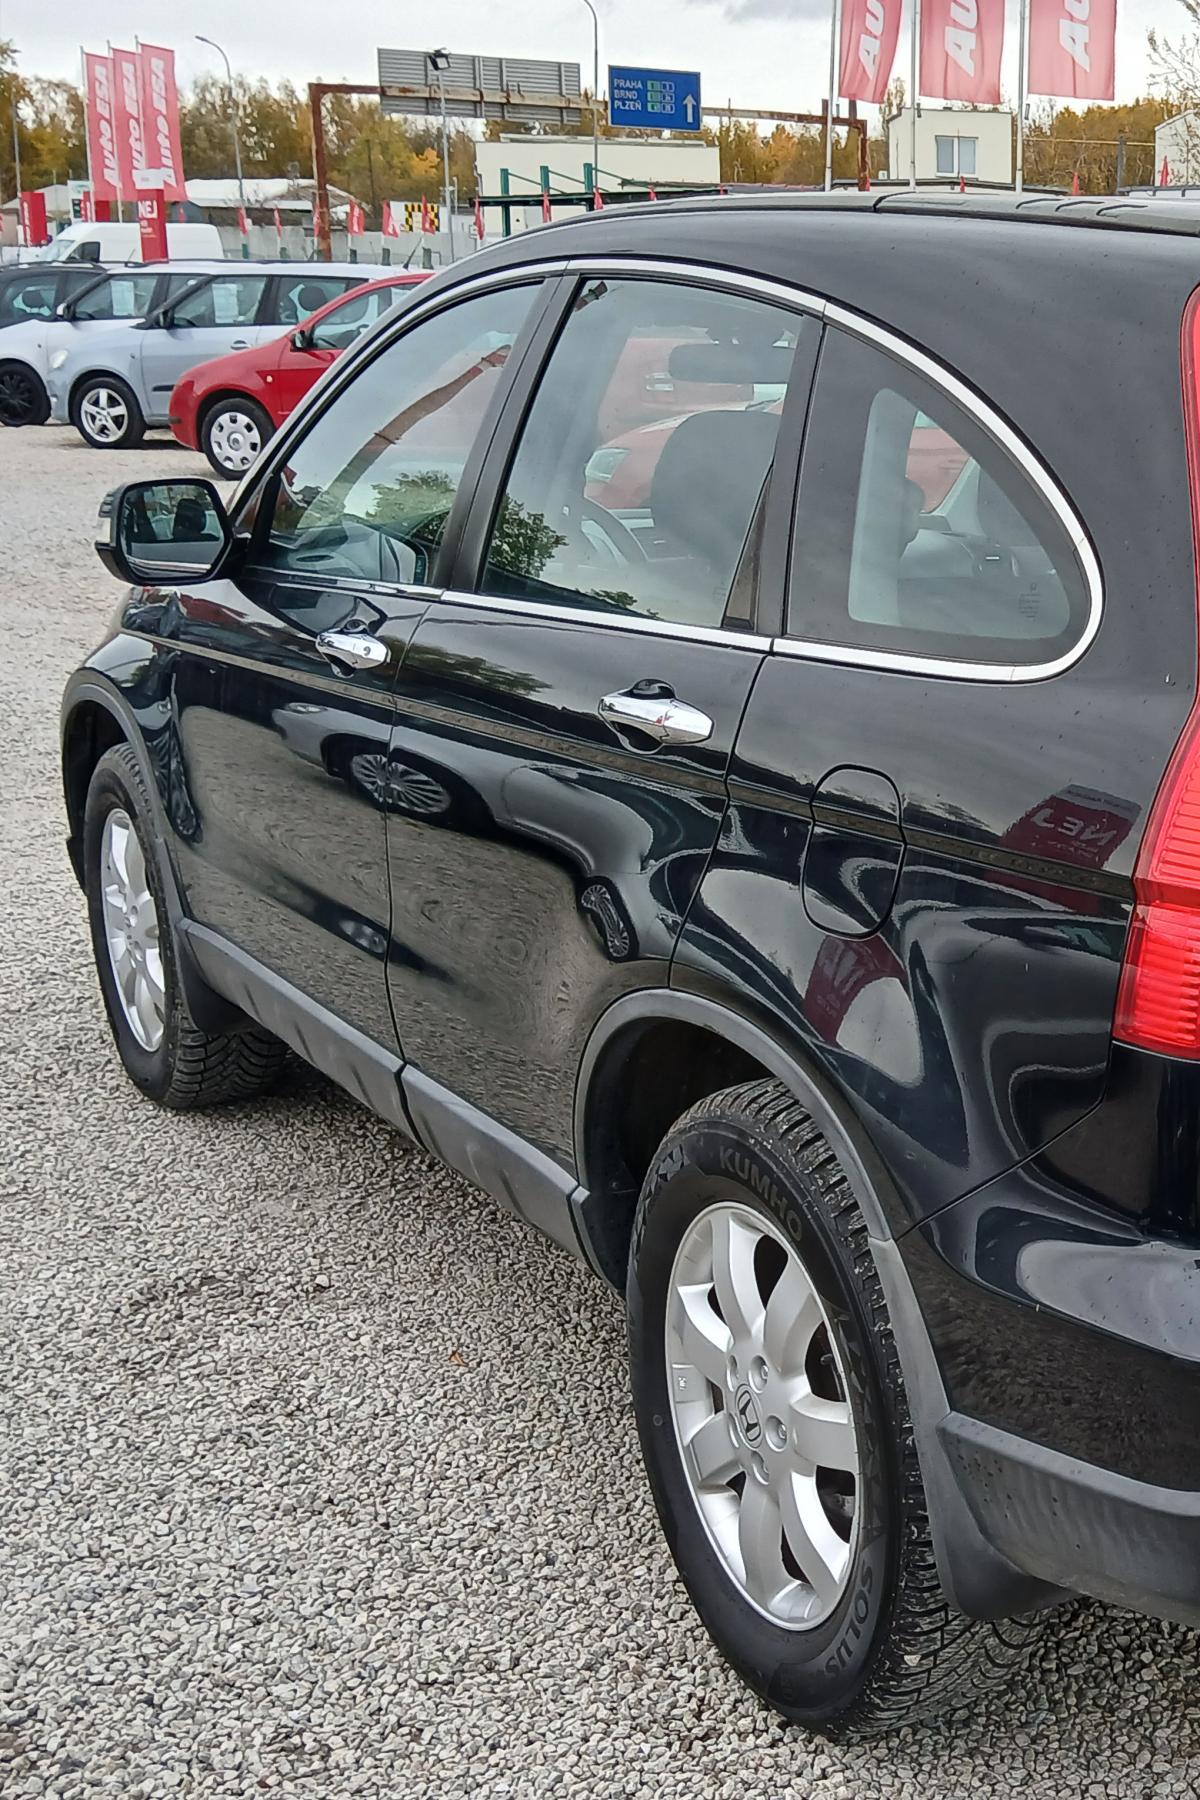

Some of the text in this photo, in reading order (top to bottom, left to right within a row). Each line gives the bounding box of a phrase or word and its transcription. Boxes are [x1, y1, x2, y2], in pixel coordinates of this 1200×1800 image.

[614, 79, 643, 90] PRAHA
[614, 90, 638, 99] BRNO
[614, 100, 642, 111] PLZEŇ
[138, 200, 158, 219] NEJ
[719, 1145, 803, 1242] KUMHO
[824, 1558, 873, 1678] SOLUS
